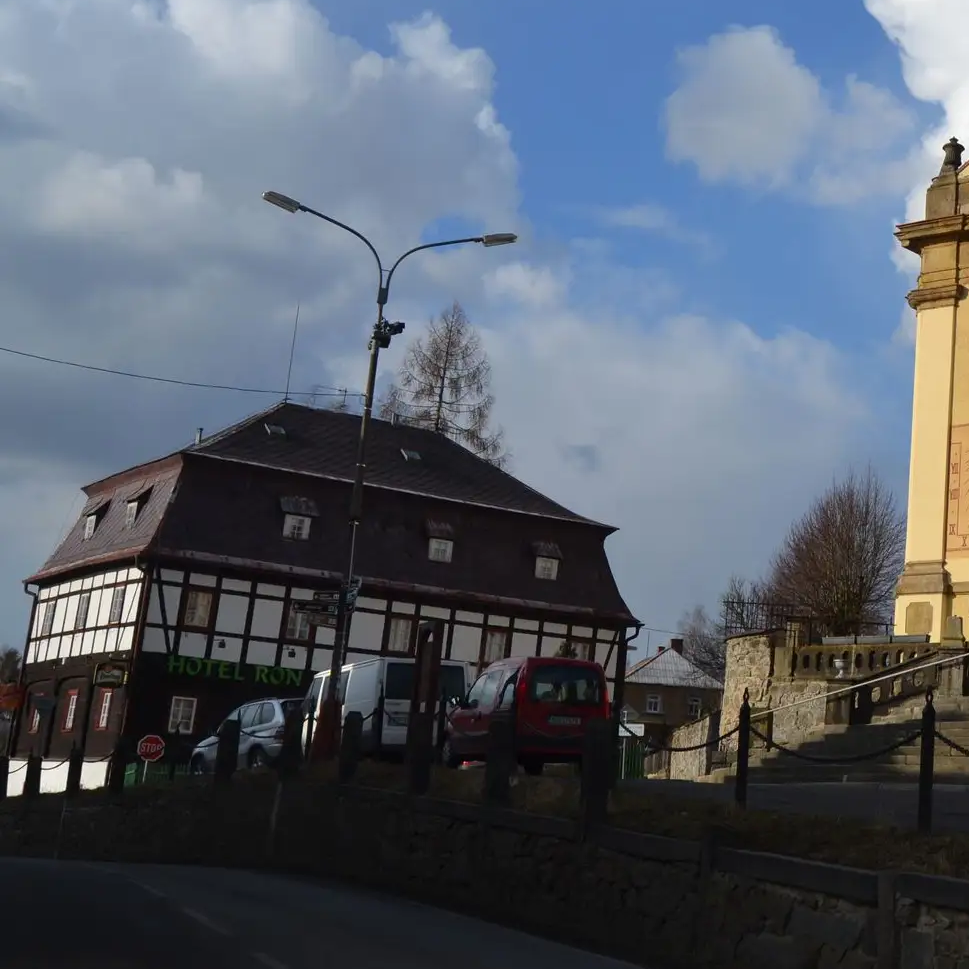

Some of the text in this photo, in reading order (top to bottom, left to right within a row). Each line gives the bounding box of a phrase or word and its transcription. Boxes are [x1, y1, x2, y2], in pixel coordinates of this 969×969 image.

[167, 655, 304, 687] HOTEL RON
[140, 742, 163, 752] STOP
